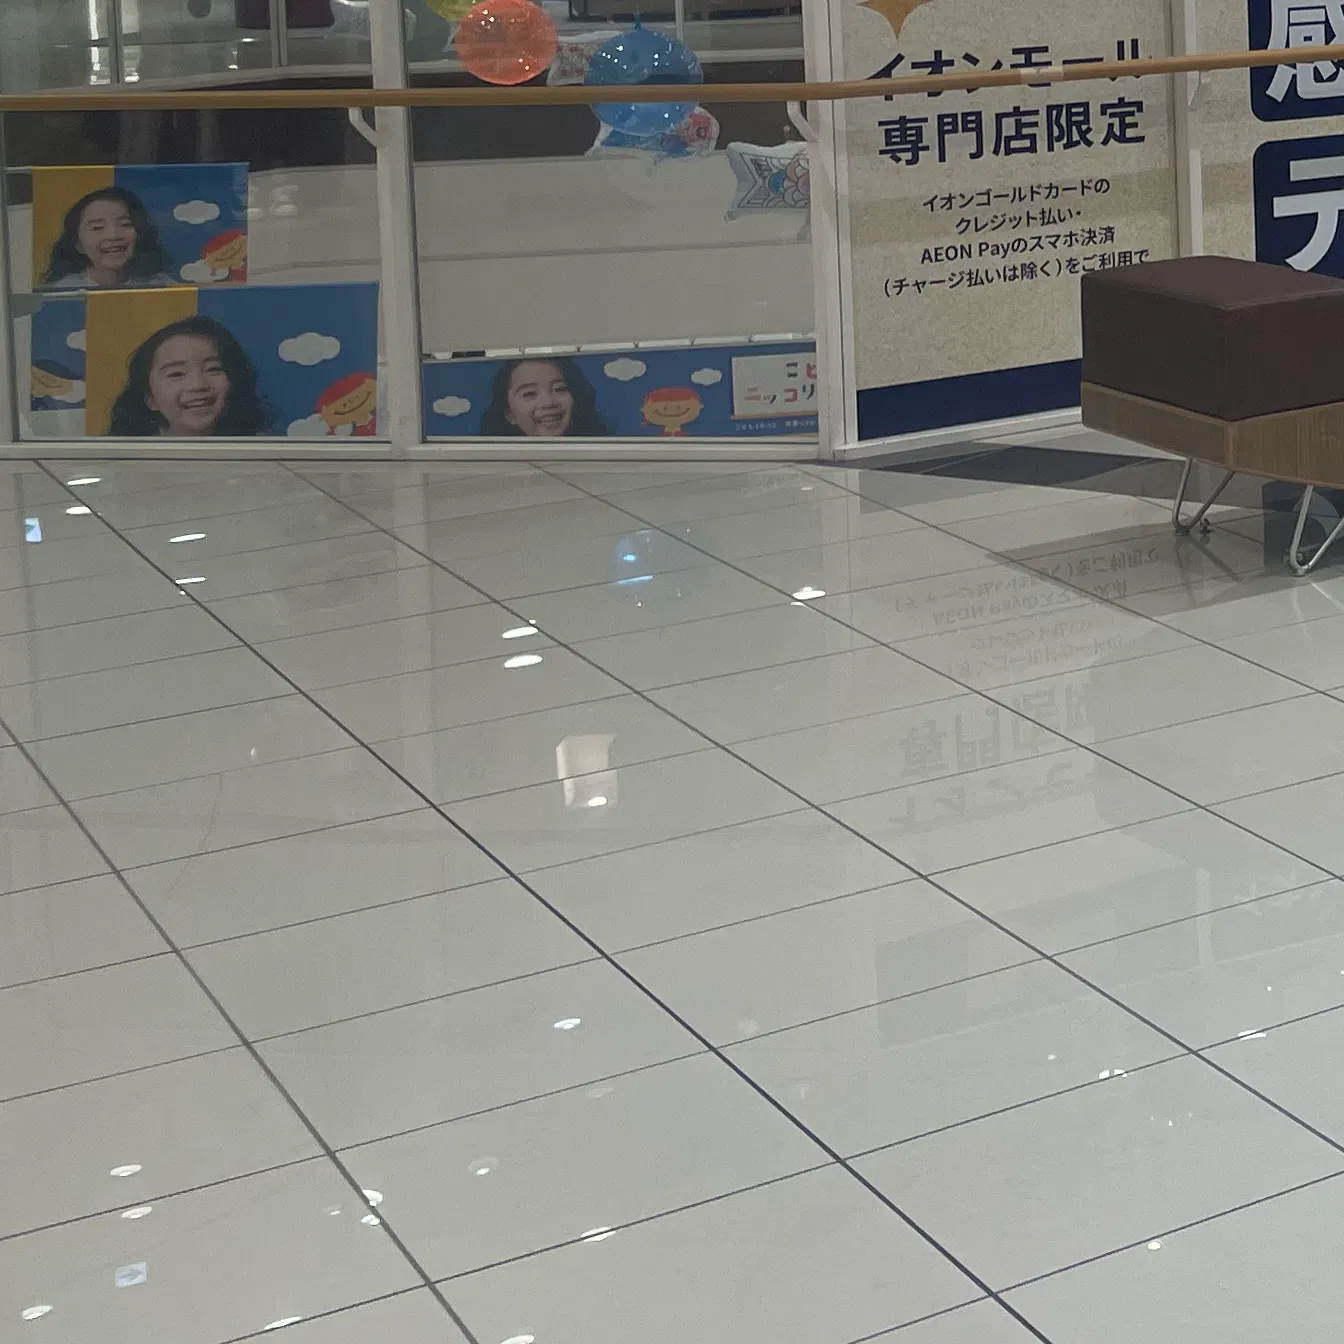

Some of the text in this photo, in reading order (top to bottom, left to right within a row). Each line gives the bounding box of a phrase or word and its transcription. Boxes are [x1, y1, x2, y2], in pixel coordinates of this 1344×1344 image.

[878, 97, 1147, 166] 専門店限定
[922, 177, 1111, 213] イオンゴールドカードの
[920, 226, 1116, 264] AEON Payのスマホ決済
